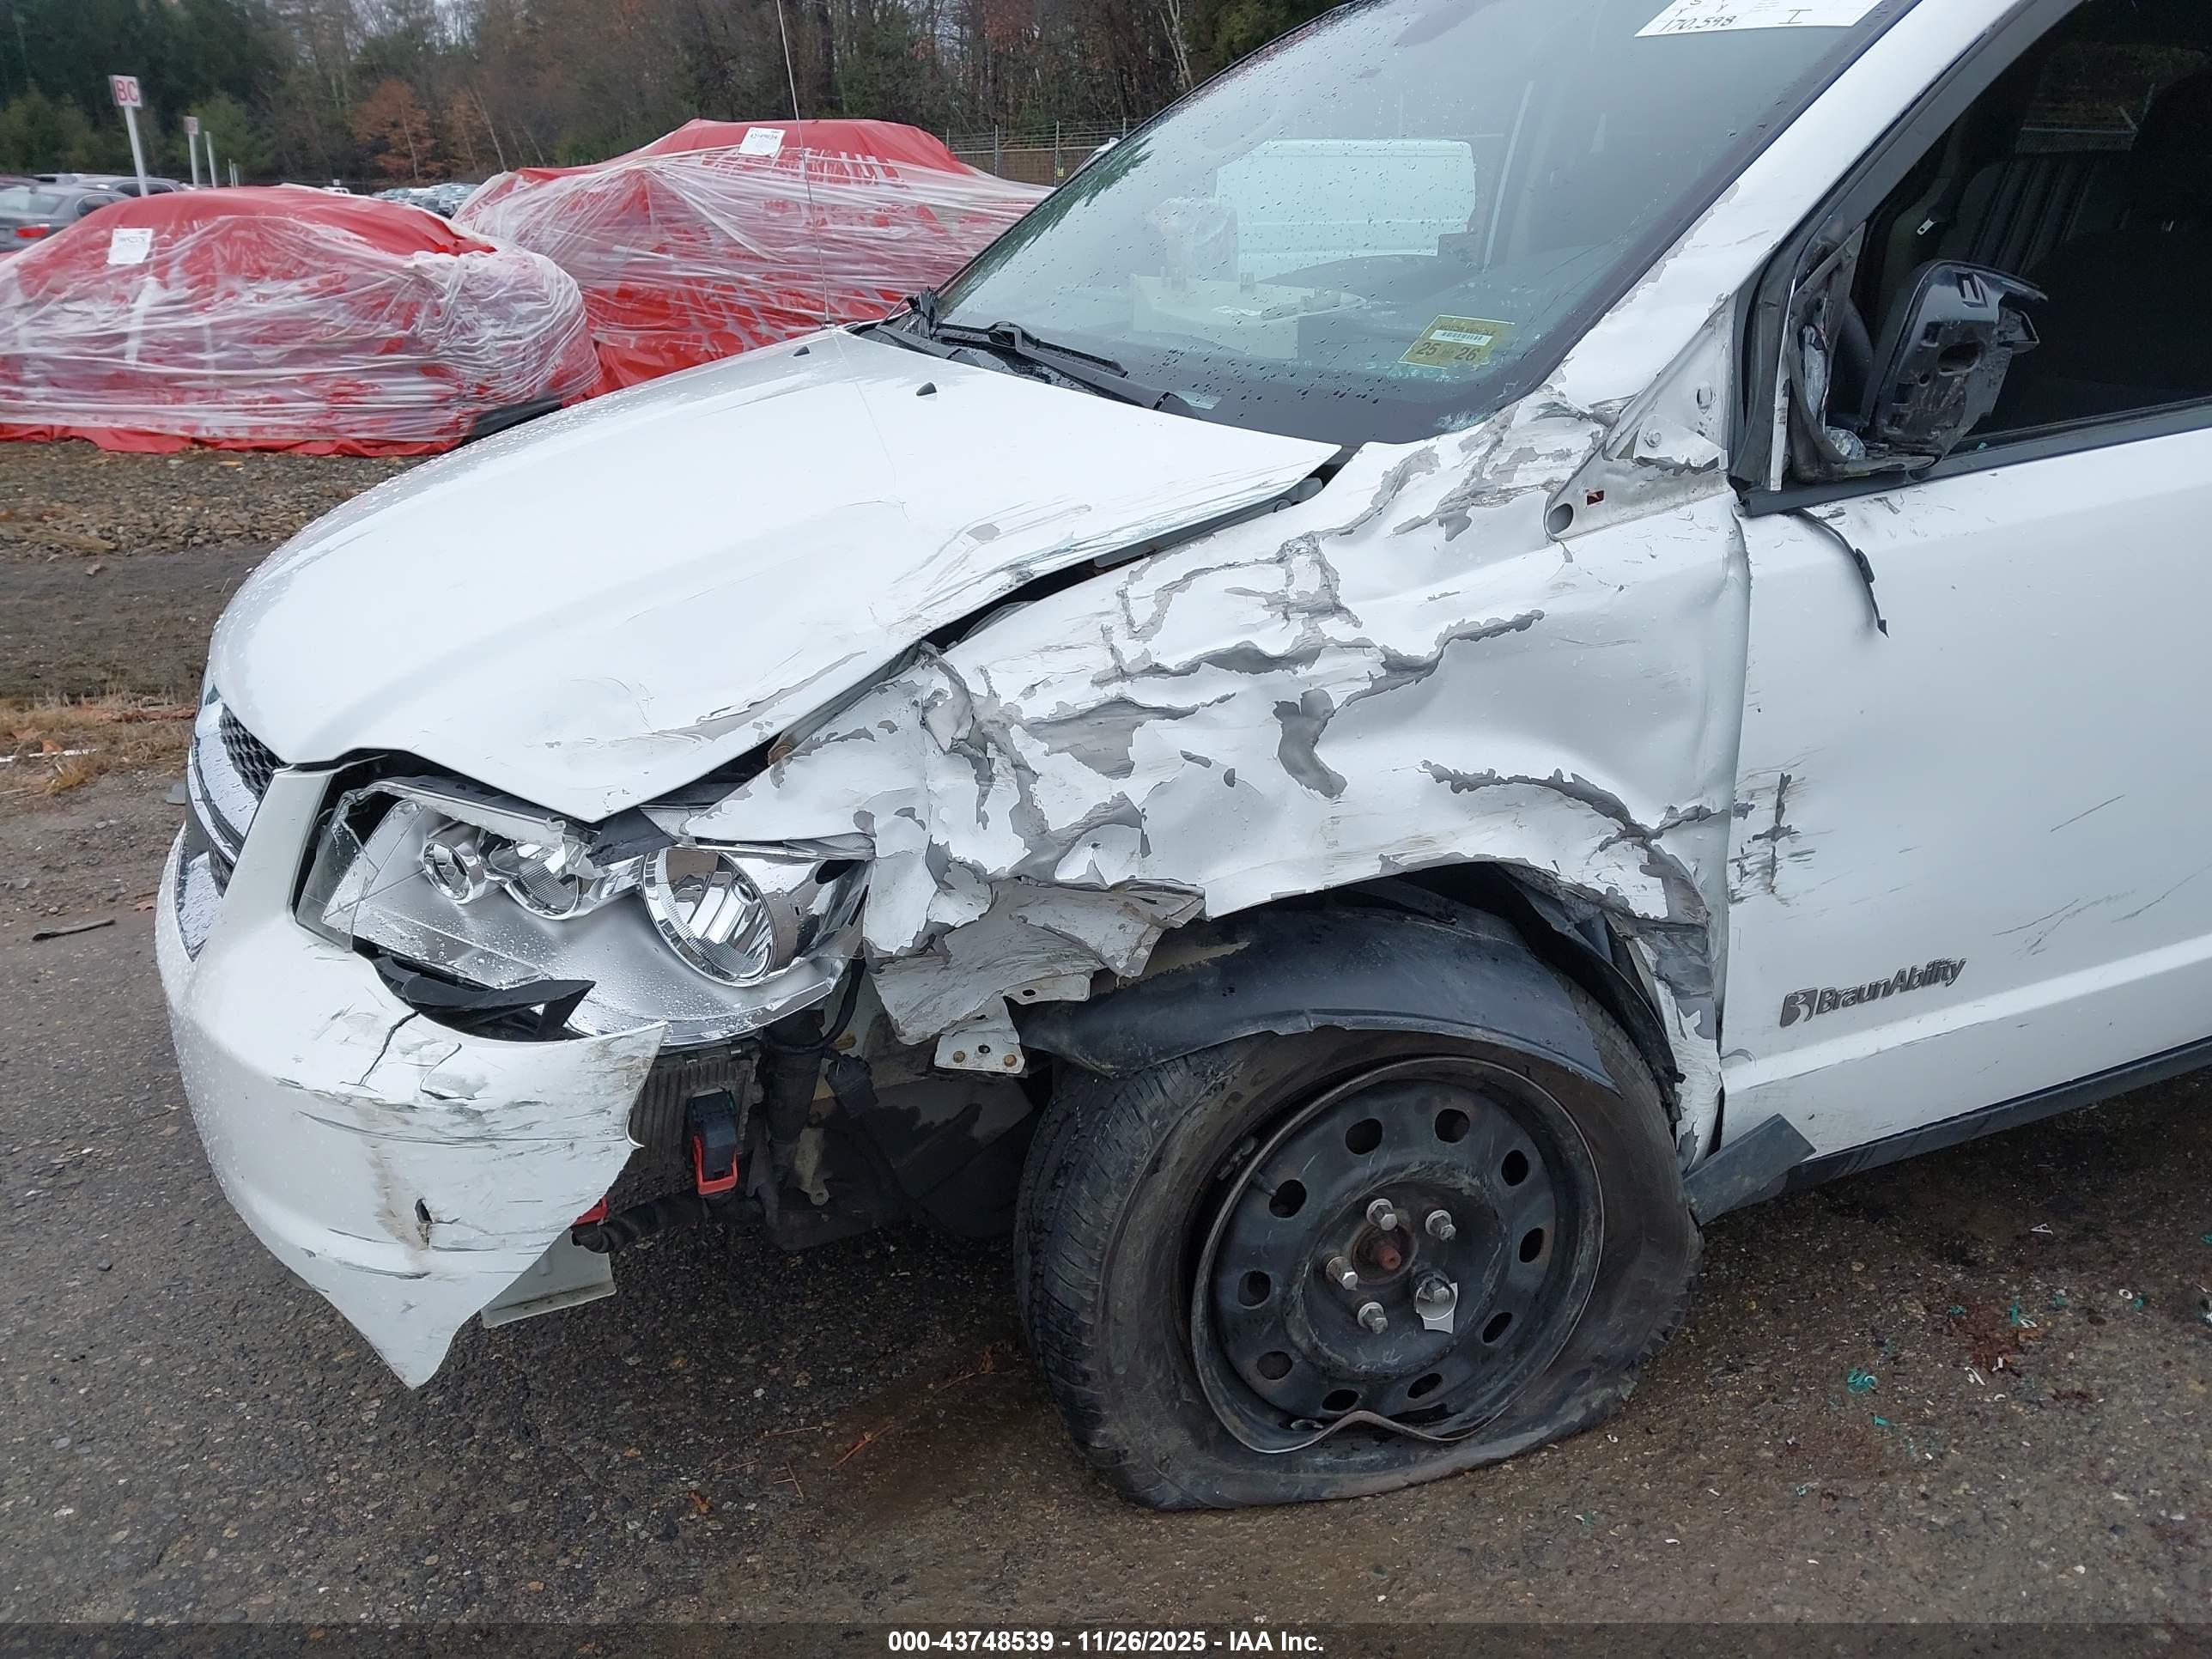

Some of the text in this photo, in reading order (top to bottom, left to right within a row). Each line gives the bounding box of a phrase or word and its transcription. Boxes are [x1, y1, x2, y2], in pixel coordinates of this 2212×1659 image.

[114, 80, 138, 102] BC
[1416, 342, 1481, 362] 25 26
[1815, 957, 1966, 1015] BraunAbility
